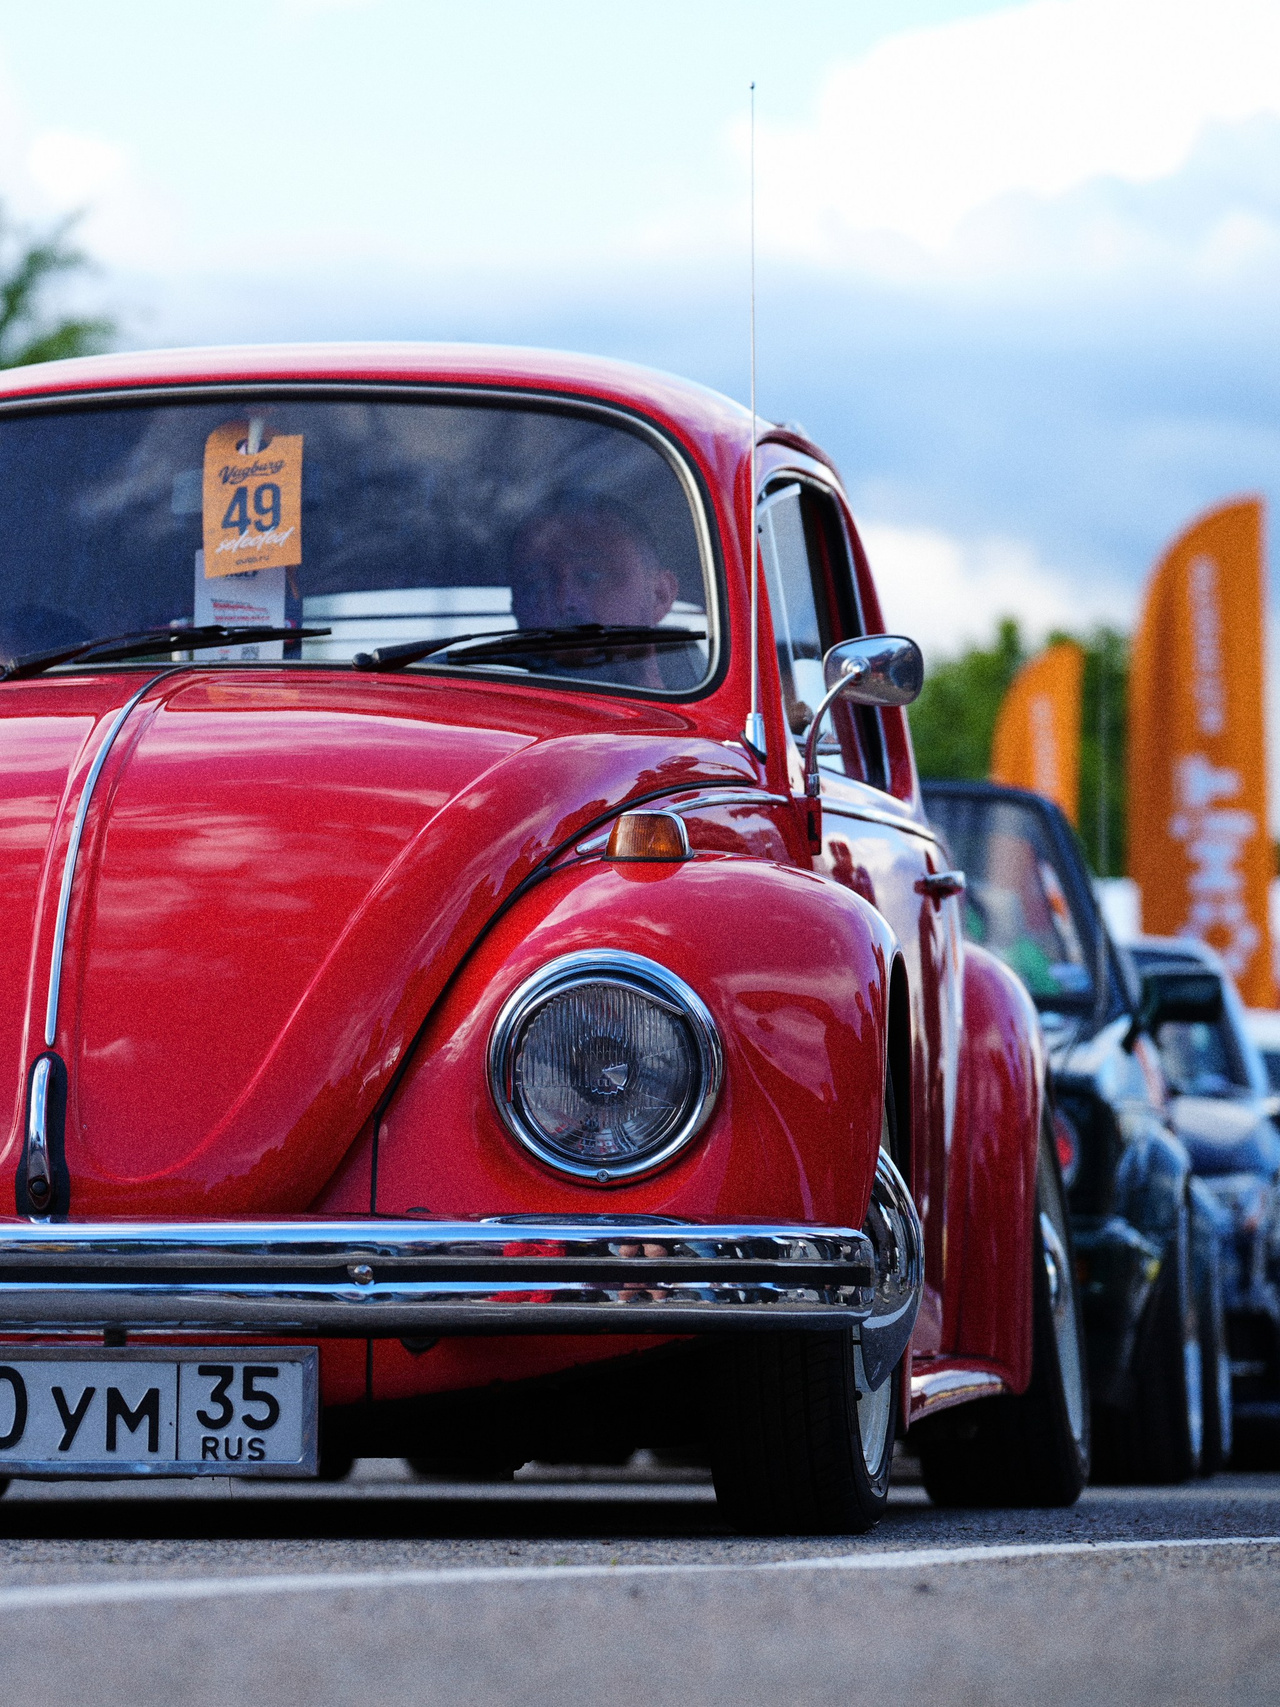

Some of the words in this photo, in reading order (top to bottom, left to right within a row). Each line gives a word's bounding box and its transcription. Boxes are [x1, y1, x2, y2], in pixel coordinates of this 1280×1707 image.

[221, 482, 281, 537] 49
[196, 1365, 280, 1431] 35
[200, 1437, 266, 1461] RUS
